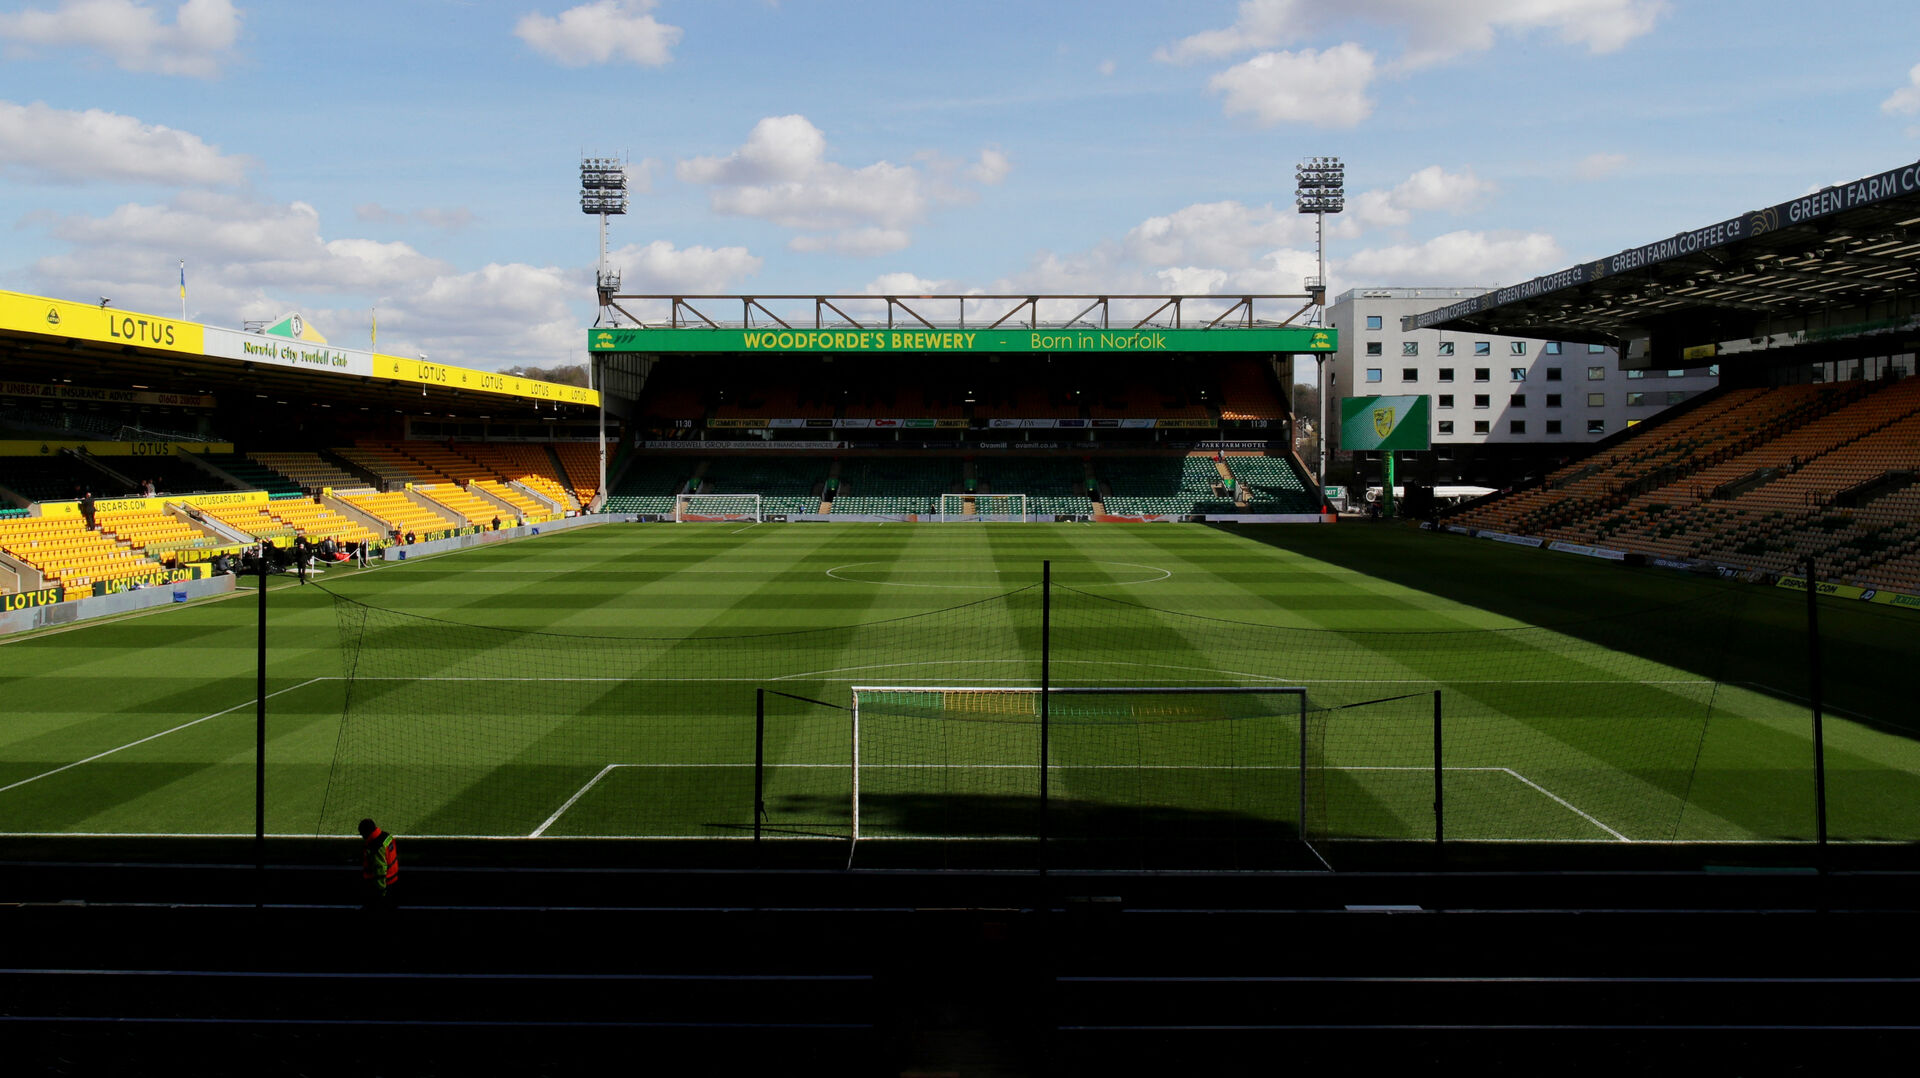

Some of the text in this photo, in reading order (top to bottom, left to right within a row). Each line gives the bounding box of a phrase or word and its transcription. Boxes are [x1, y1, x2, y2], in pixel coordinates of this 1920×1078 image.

[1789, 190, 1842, 222] GREEN
[1847, 172, 1897, 206] FARM
[1612, 248, 1645, 273] GREEN
[1647, 240, 1677, 263] FARM
[1679, 225, 1724, 253] COFFEE
[1497, 287, 1520, 304] GREEN
[1521, 281, 1542, 298] FARM
[1542, 272, 1572, 292] COFFEE
[1417, 314, 1434, 327] GREEN
[1434, 307, 1449, 324] FARM
[1449, 302, 1470, 319] COFFEE
[110, 315, 174, 346] LOTUS
[743, 332, 885, 349] WOODFORDE'S
[891, 332, 976, 349] BREWERY
[1032, 333, 1076, 349] Born
[1078, 332, 1094, 349] in
[1101, 332, 1167, 349] Norfolk
[243, 341, 348, 368] Norwich City Football Club
[418, 364, 446, 382] LOTUS
[481, 374, 503, 390] LOTUS
[530, 383, 549, 397] LOTUS
[62, 387, 105, 399] INSURANCE
[571, 389, 587, 402] LOTUS
[675, 419, 692, 428] 11:30
[131, 443, 169, 455] LOTUS
[95, 501, 147, 513] USCARS.COM
[195, 494, 246, 506] LOTUSCARS.COM
[427, 530, 445, 541] LOTUS
[460, 525, 475, 537] LOTUS
[104, 565, 194, 595] LOTUSCARS.COM
[5, 588, 57, 611] LOTUS
